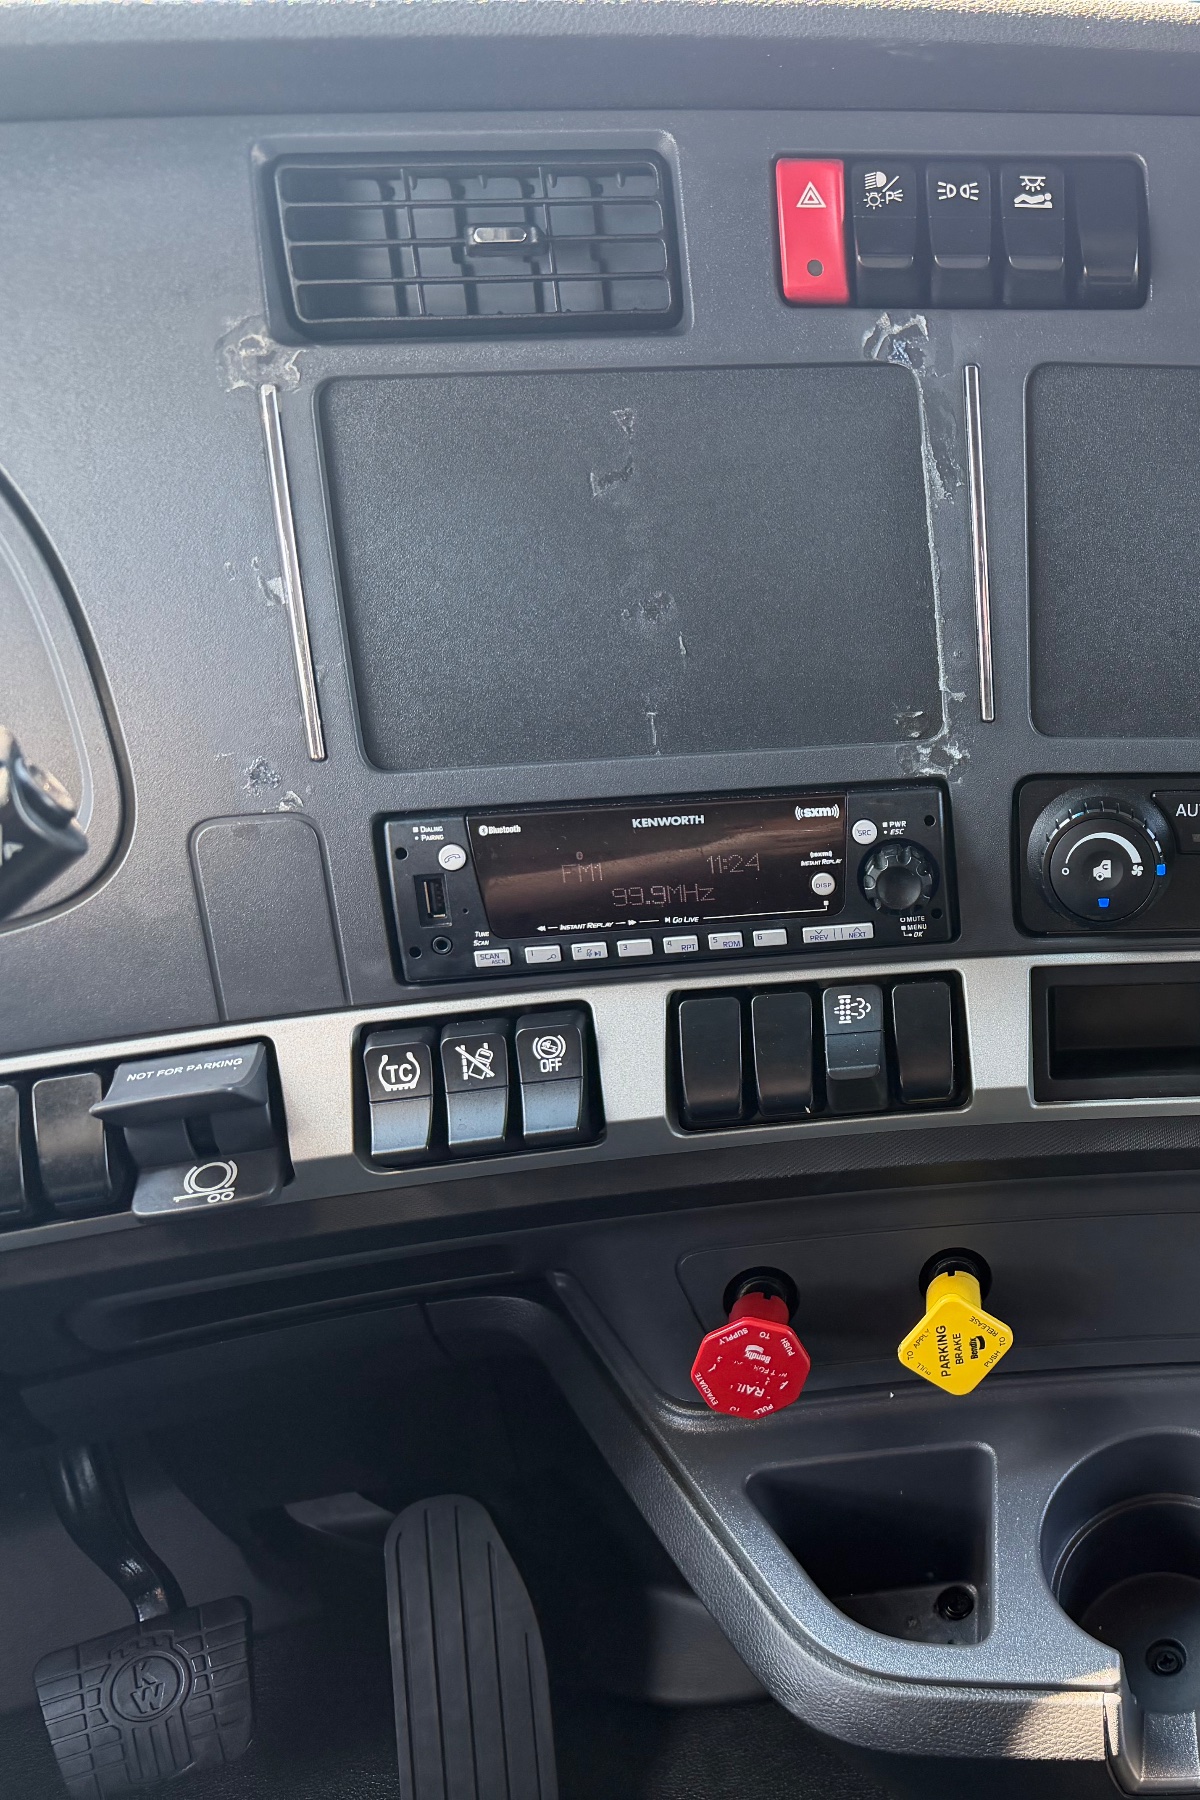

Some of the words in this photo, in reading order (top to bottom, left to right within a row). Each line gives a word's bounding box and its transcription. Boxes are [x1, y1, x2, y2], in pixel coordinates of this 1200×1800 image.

[488, 825, 521, 834] Bluetooth
[632, 815, 704, 829] KENWORTH
[561, 862, 603, 883] FM1
[706, 853, 760, 874] 11:24
[611, 883, 716, 906] 99.9MHz
[681, 943, 696, 951] RPT
[722, 940, 741, 948] RDM
[809, 934, 829, 942] PREV
[127, 1071, 154, 1082] NOT
[156, 1066, 184, 1077] FOR
[186, 1058, 243, 1072] PARKING
[385, 1063, 413, 1083] TC
[540, 1057, 563, 1073] OFF
[969, 1315, 999, 1337] RELEASE
[719, 1327, 749, 1346] SUPPLY
[759, 1331, 770, 1340] TO
[906, 1351, 914, 1361] TO
[913, 1328, 931, 1349] APPLY
[999, 1337, 1006, 1347] TO
[780, 1337, 796, 1357] PUSH
[935, 1325, 952, 1377] PARKING
[953, 1333, 964, 1365] BRAKE
[744, 1350, 772, 1364] Bendix
[984, 1350, 1001, 1368] PUSH
[694, 1371, 719, 1406] EVACUATE
[753, 1403, 774, 1415] PULL
